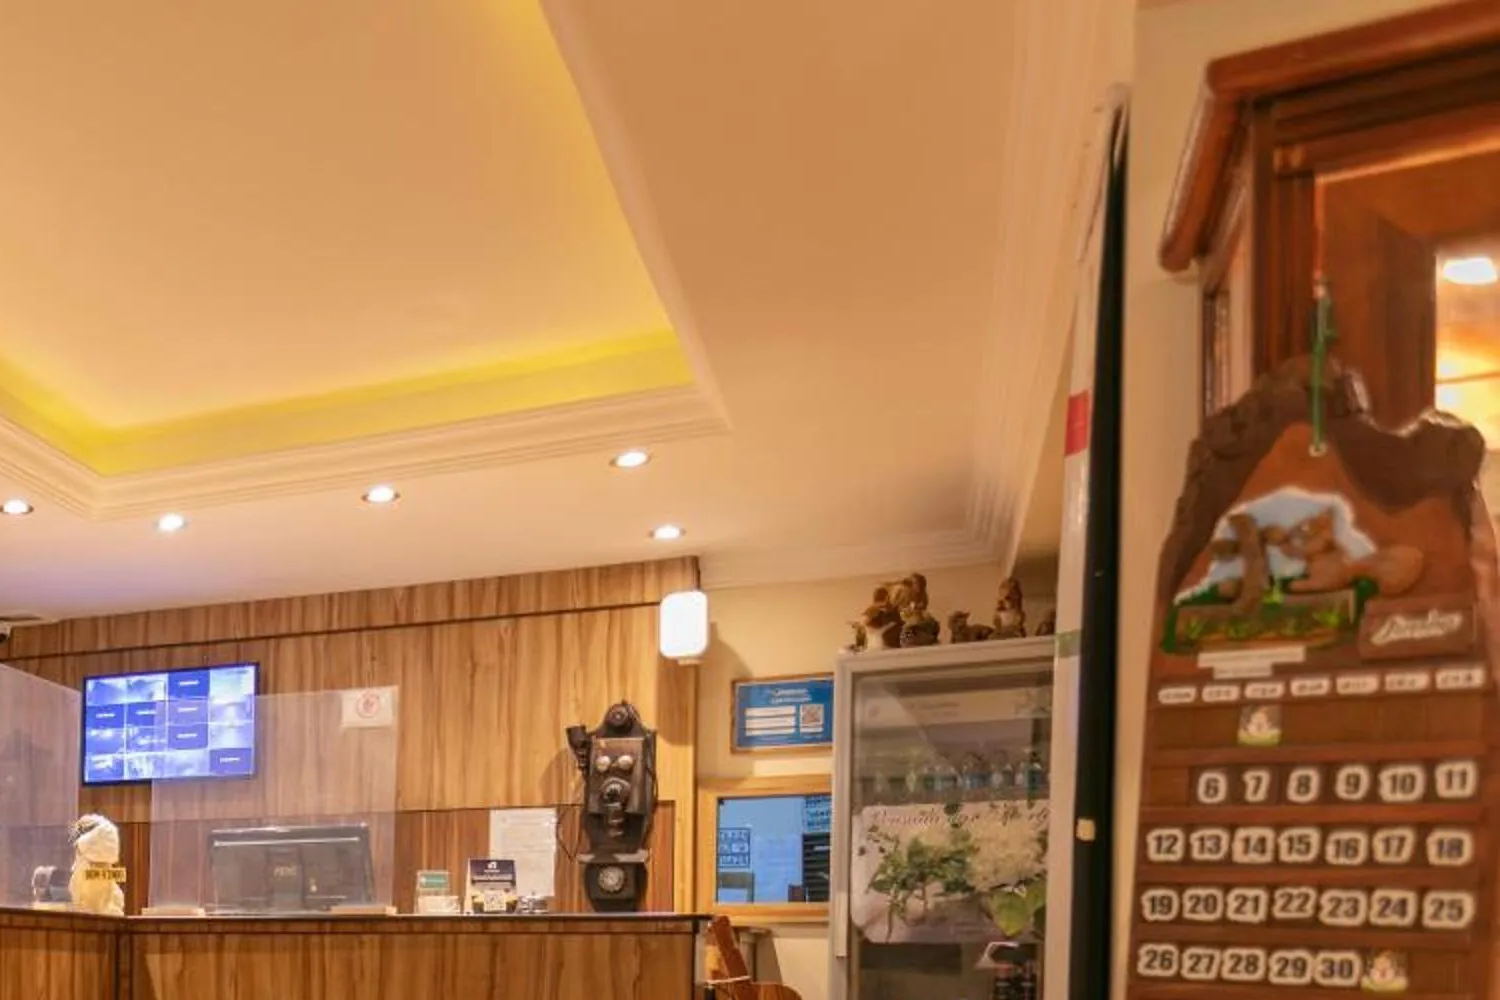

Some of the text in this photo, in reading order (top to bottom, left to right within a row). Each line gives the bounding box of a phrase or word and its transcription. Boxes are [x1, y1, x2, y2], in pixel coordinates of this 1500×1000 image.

[1203, 766, 1470, 798] 6 7 8 9 10 11
[1151, 833, 1464, 859] 12 13 14 15 16 17 18
[1148, 891, 1465, 923] 19 20 21 22 23 24 25
[1142, 948, 1353, 980] 26 27 28 29 30
